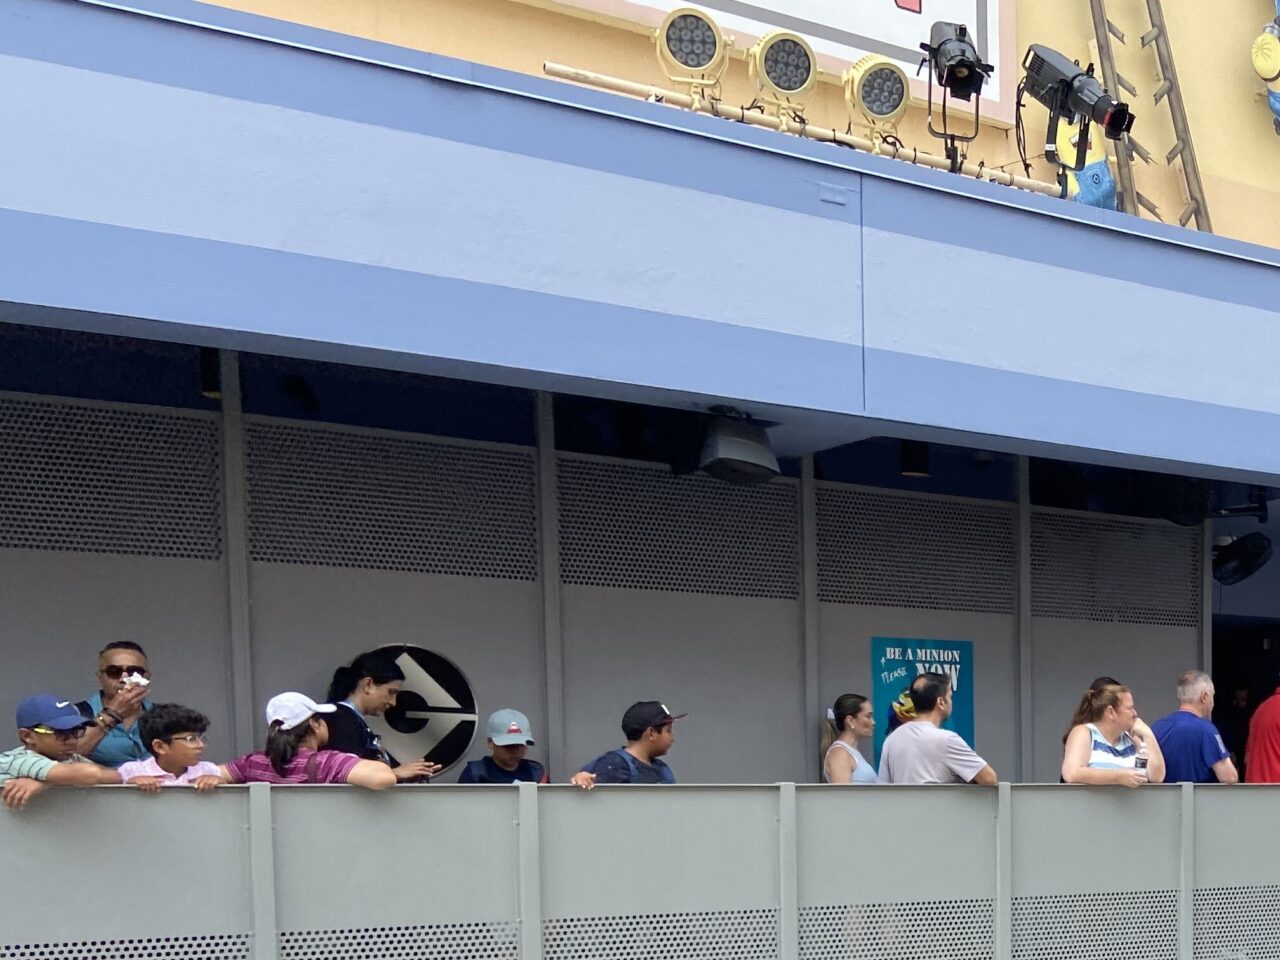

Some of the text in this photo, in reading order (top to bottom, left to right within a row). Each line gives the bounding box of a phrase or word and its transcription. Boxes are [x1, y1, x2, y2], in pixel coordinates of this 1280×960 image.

[886, 647, 961, 662] BE A MINION
[881, 666, 908, 685] PLEASE
